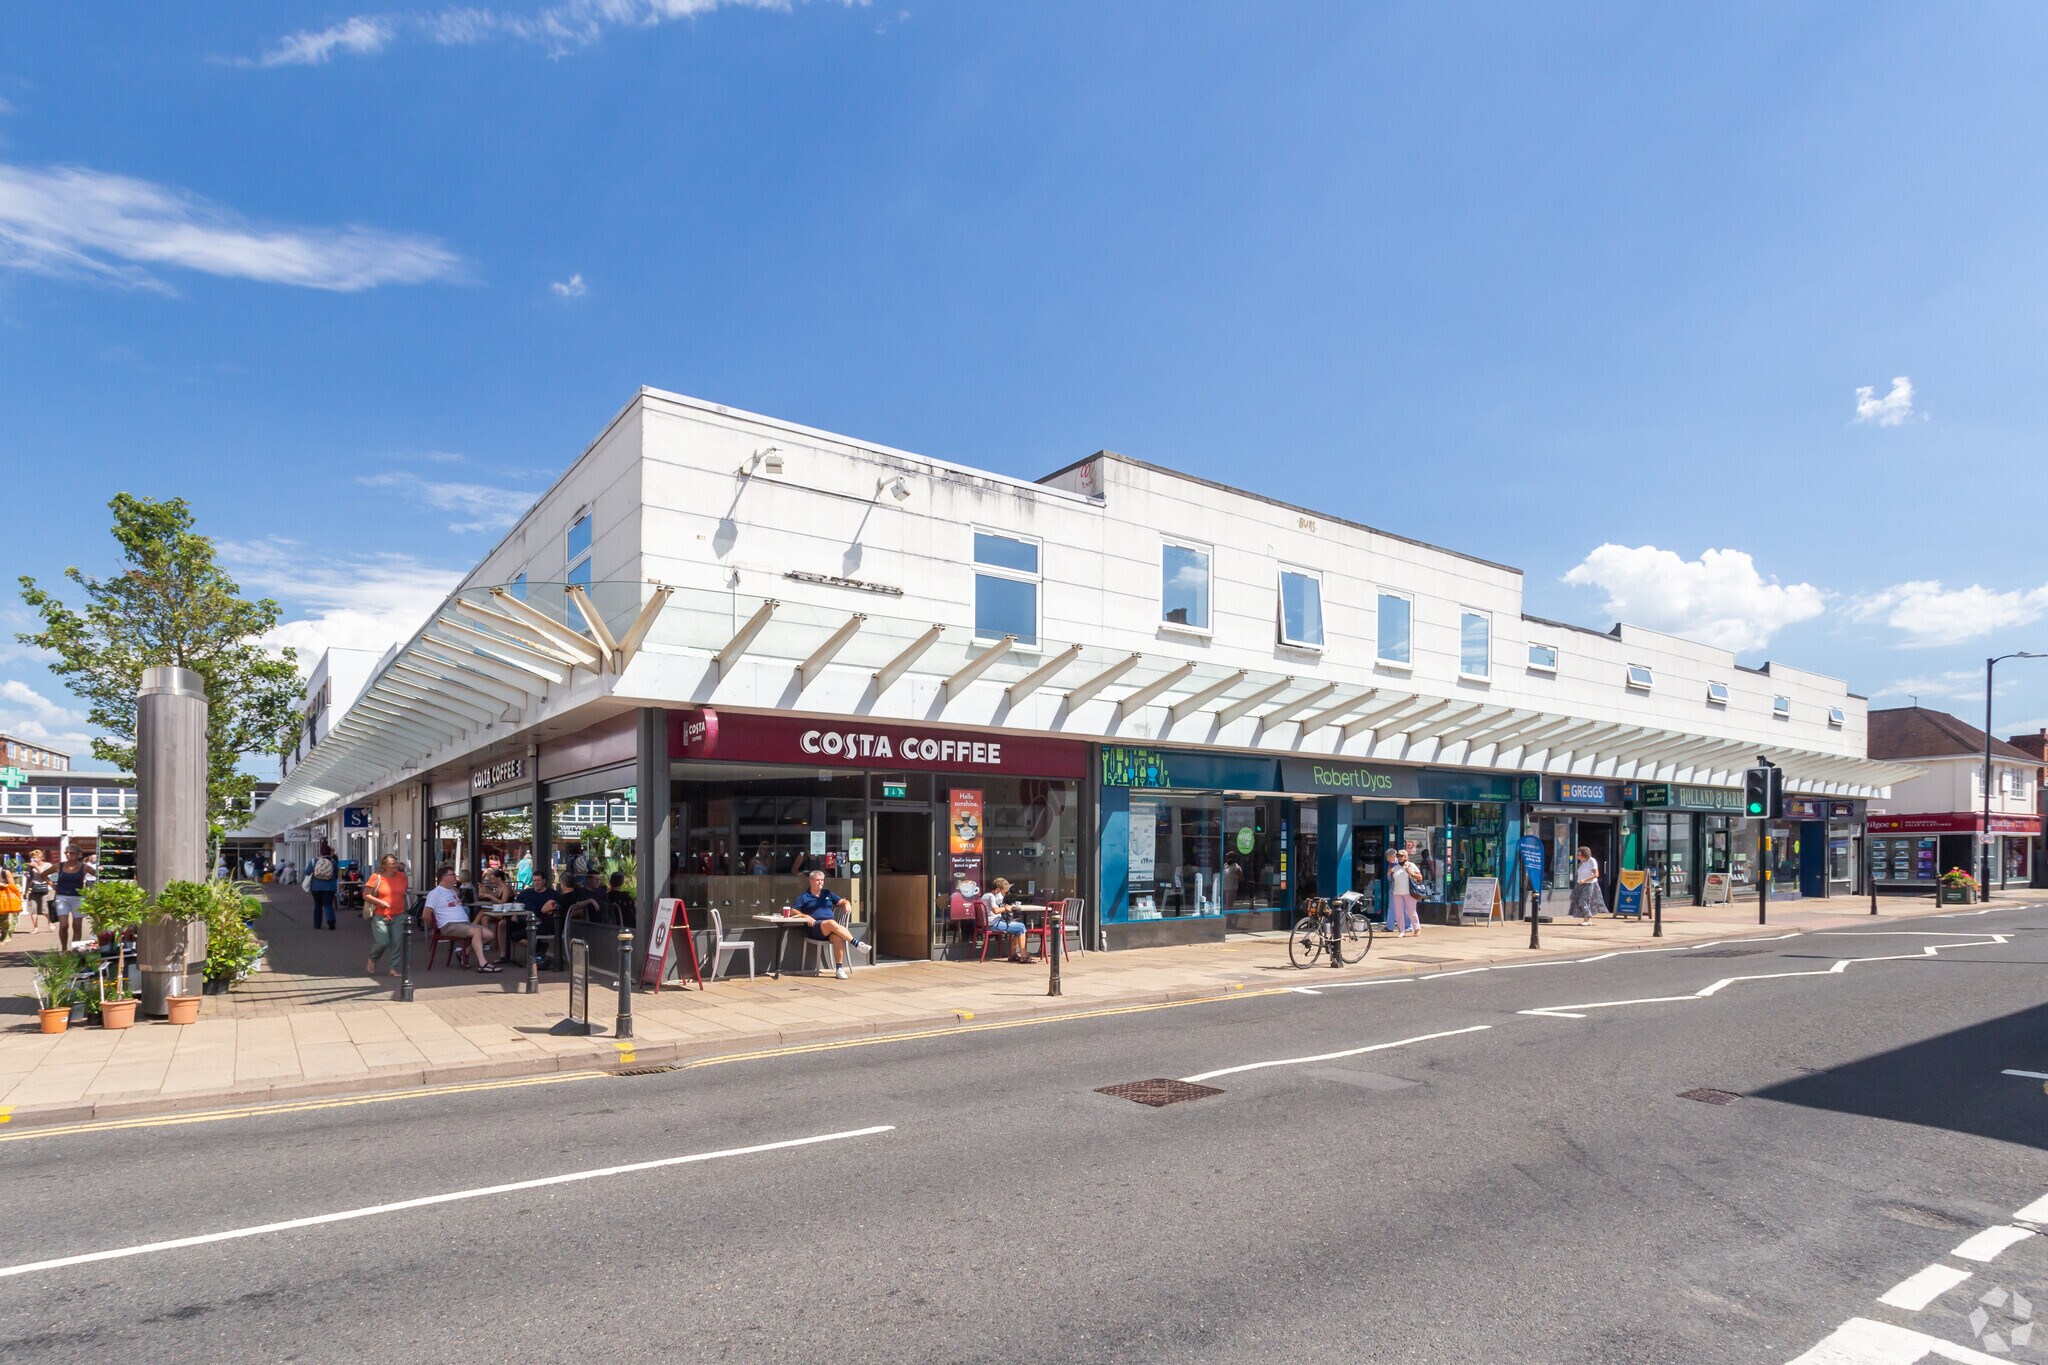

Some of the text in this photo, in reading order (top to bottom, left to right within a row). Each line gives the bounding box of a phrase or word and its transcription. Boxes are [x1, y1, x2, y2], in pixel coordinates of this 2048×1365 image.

[689, 721, 706, 735] COSTA
[800, 730, 1001, 764] COSTA COFFEE
[474, 759, 517, 788] COSTA COFFEE
[1313, 765, 1392, 792] Robert Dyas
[959, 792, 974, 800] Hello
[1571, 784, 1603, 799] GREGGS
[1680, 788, 1715, 807] HOLLAND
[1715, 790, 1723, 809] &
